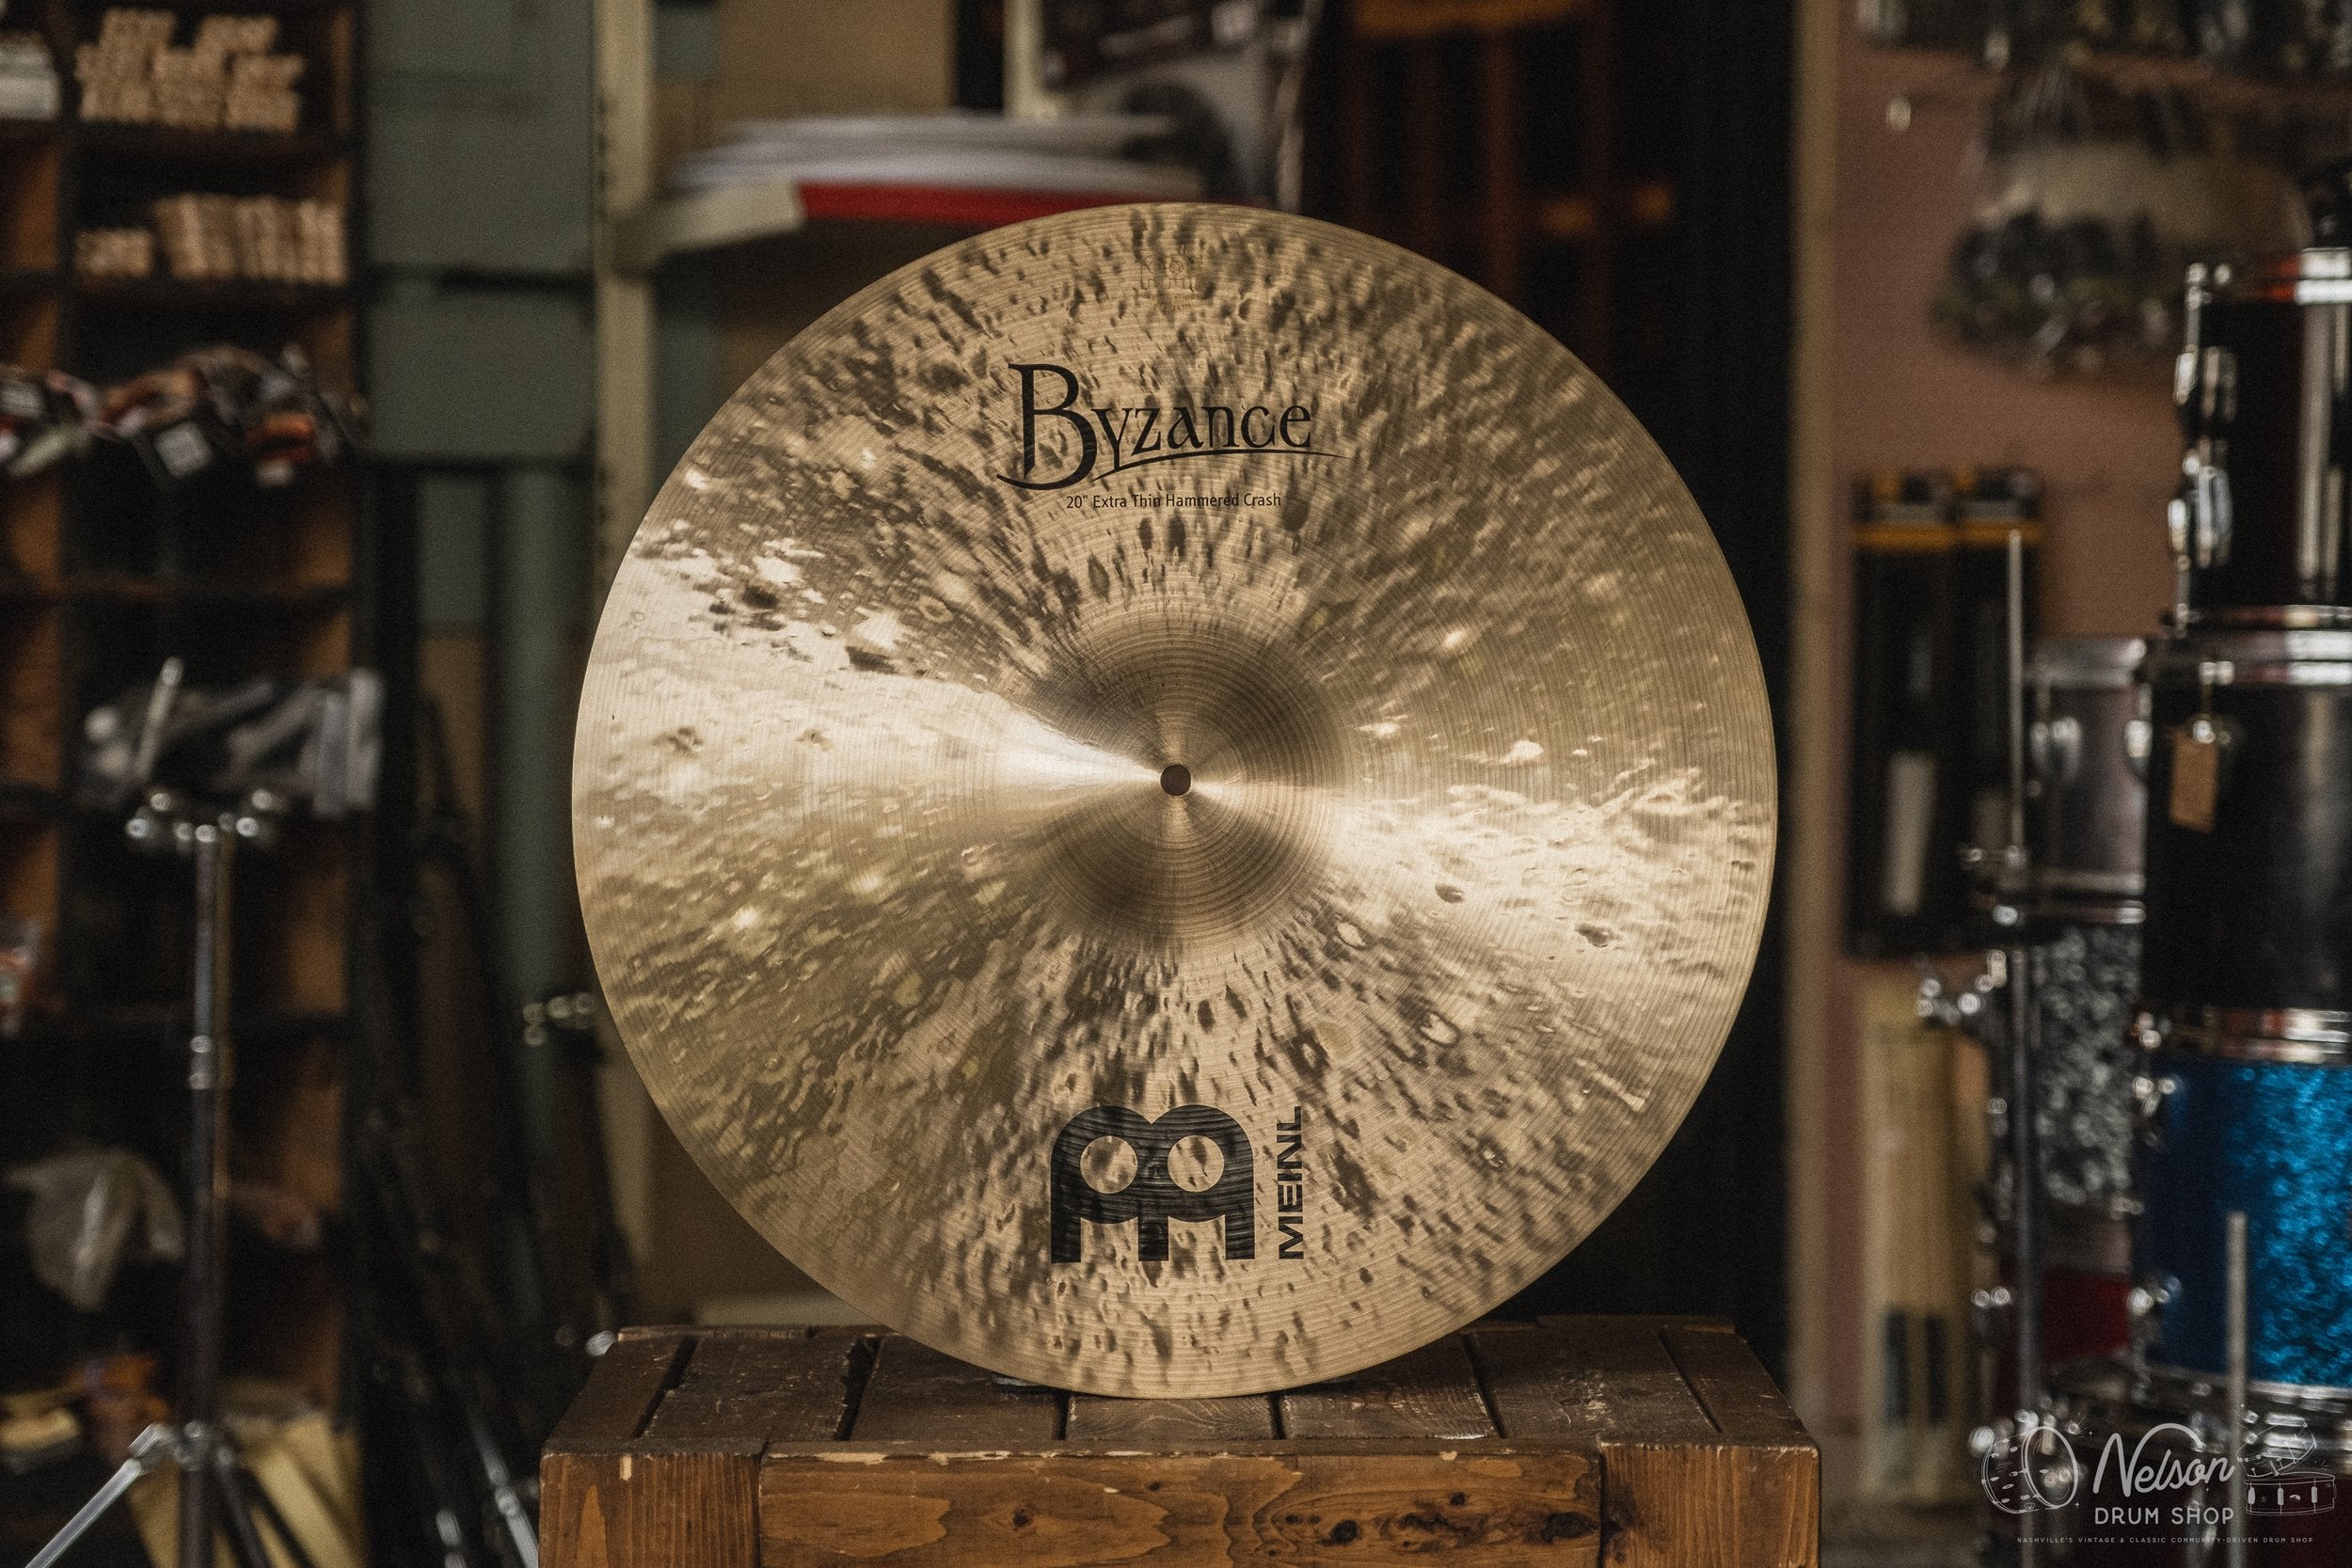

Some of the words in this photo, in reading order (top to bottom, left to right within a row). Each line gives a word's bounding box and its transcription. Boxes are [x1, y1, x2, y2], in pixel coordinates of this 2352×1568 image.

[996, 363, 1311, 490] Byzance
[1066, 495, 1089, 508] 20"
[1093, 495, 1127, 508] Extra
[1132, 494, 1161, 507] Thin
[1166, 493, 1239, 507] Hammered
[1244, 493, 1281, 506] Crash
[1276, 1105, 1305, 1259] MEINL
